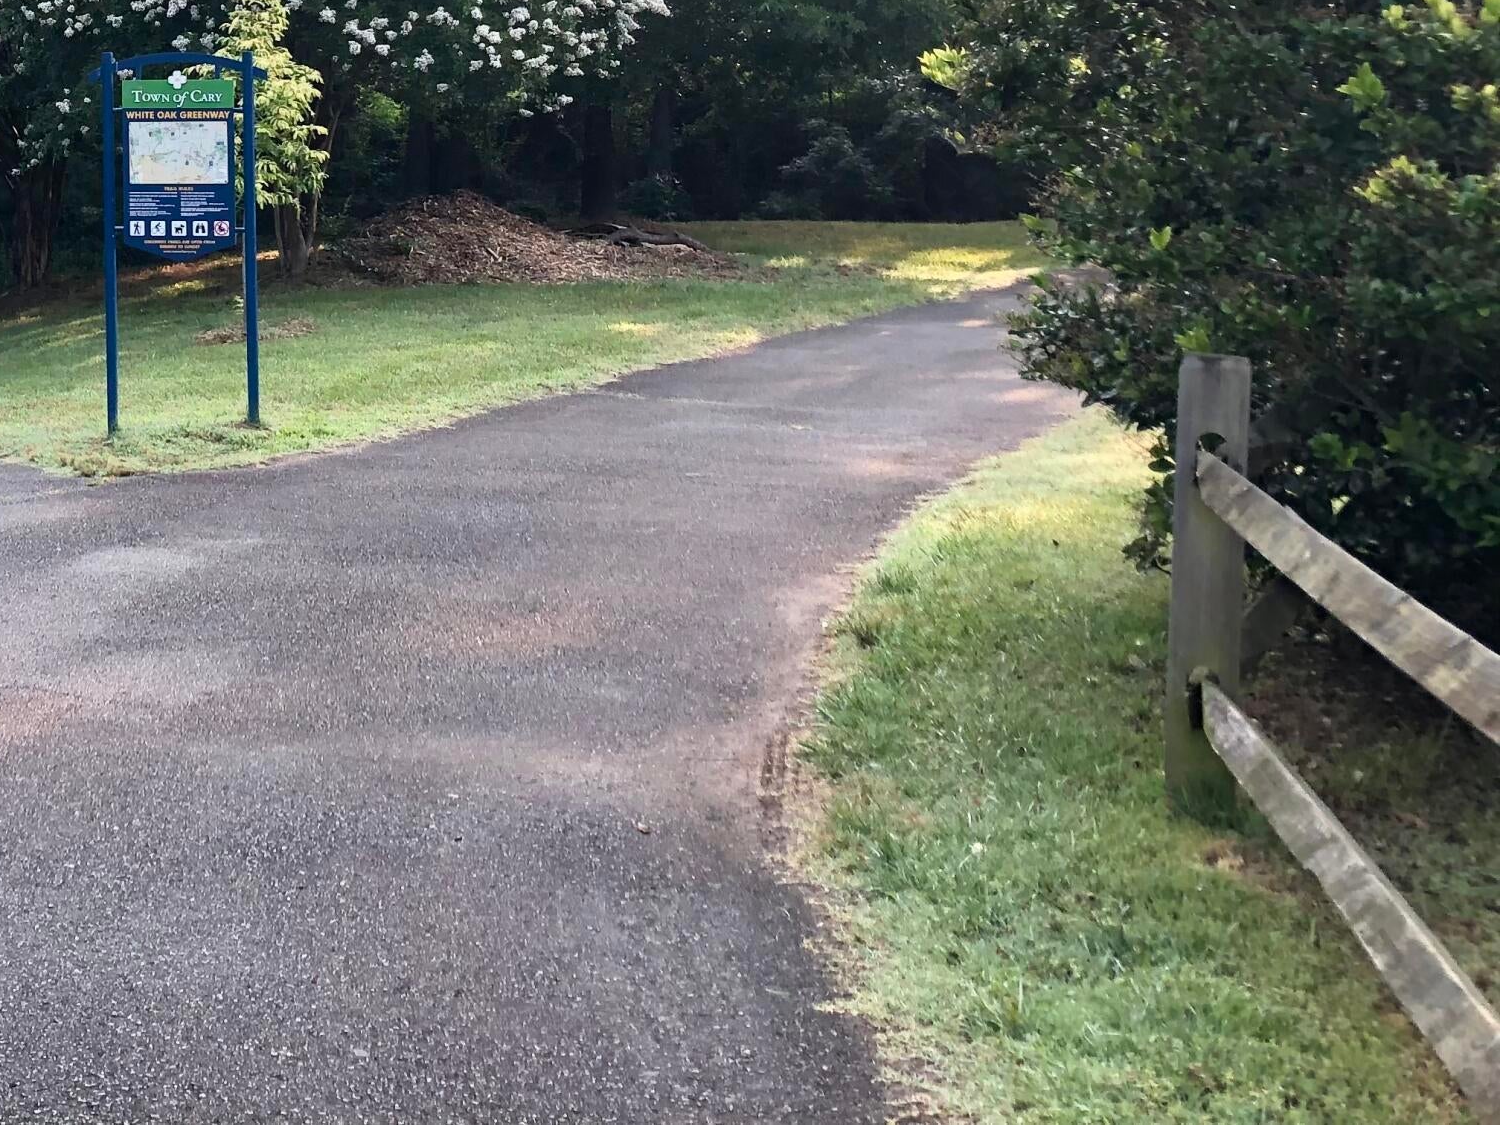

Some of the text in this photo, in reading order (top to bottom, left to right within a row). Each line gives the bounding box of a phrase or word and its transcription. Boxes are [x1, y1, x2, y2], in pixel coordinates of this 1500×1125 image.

[173, 91, 189, 108] of
[126, 110, 230, 119] WHITE OAK GREENWAY
